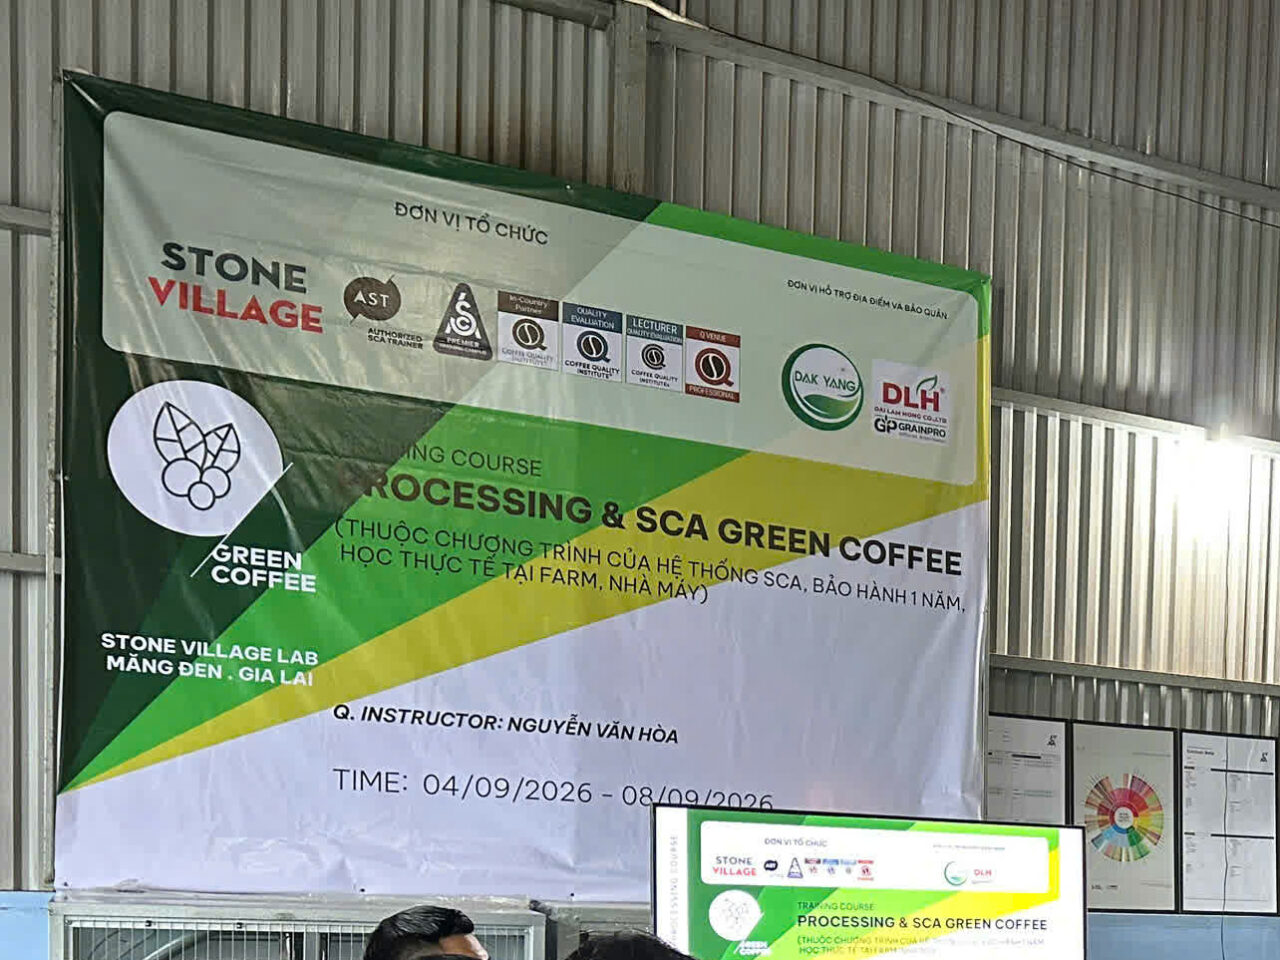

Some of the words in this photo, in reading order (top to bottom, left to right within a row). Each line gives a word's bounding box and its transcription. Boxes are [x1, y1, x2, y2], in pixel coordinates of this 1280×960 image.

[395, 202, 437, 223] ĐƠN
[443, 211, 460, 231] VỊ
[465, 213, 490, 233] TỔ
[495, 222, 549, 245] CHỨC
[161, 242, 307, 294] STONE
[148, 276, 323, 334] VILLAGE
[353, 290, 389, 308] AST
[571, 315, 614, 330] EVALUATION
[577, 307, 607, 317] QUALITY
[367, 327, 423, 343] AUTHORIZED
[633, 318, 677, 335] LECTURER
[384, 337, 423, 350] TRAINER
[565, 360, 590, 369] COFFEE
[591, 364, 620, 374] QUALITY
[631, 369, 653, 378] COFFEE
[654, 373, 679, 382] QUALITY
[794, 370, 818, 384] DAK
[823, 376, 856, 392] YANG
[883, 382, 939, 412] DLH
[898, 422, 946, 438] GRAINPRO
[451, 449, 543, 477] COURSE
[348, 465, 592, 524] ROCESSING
[601, 501, 626, 530] &
[636, 505, 709, 541] SCA
[718, 517, 830, 558] GREEN
[839, 535, 962, 576] COFFEE
[212, 544, 302, 571] GREEN
[334, 518, 429, 547] (THUỘC
[434, 529, 533, 556] CHƯƠNG
[539, 539, 601, 565] TRÌNH
[606, 547, 651, 571] CỦA
[657, 554, 682, 578] HỆ
[688, 557, 758, 584] THỐNG
[763, 570, 808, 594] SCA,
[813, 573, 851, 598] BẢO
[856, 580, 907, 605] HÀNH
[910, 591, 917, 606] 1
[922, 589, 966, 613] NĂM,
[211, 565, 316, 593] COFFEE
[340, 545, 393, 568] HỌC
[400, 551, 462, 576] THỰC
[469, 553, 495, 577] TẾ
[501, 562, 534, 586] TẠI
[540, 567, 603, 591] FARM,
[609, 573, 651, 596] NHÀ
[657, 578, 708, 605] MÁY)
[101, 633, 176, 654] STONE
[181, 640, 272, 662] VILLAGE
[277, 648, 319, 666] LAB
[106, 653, 174, 675] MĂNG
[178, 662, 222, 679] ĐEN
[239, 667, 275, 684] GIA
[280, 669, 313, 687] LAI
[333, 703, 356, 722] Q.
[360, 706, 504, 731] INSTRUCTOR:
[507, 713, 592, 738] NGUYỄN
[597, 720, 635, 742] VĂN
[638, 724, 679, 745] HÒA
[332, 768, 408, 793] TIME:
[422, 773, 593, 804] 04/09/2026
[622, 786, 773, 809] 08/09/2026
[712, 867, 756, 877] VILLAGE
[716, 856, 752, 865] STONE
[797, 902, 838, 910] TRAINING
[840, 903, 875, 911] COURSE
[797, 915, 895, 928] PROCESSING
[899, 917, 908, 928] &
[913, 917, 941, 929] SCA
[945, 918, 991, 929] GREEN
[995, 919, 1047, 930] COFFEE
